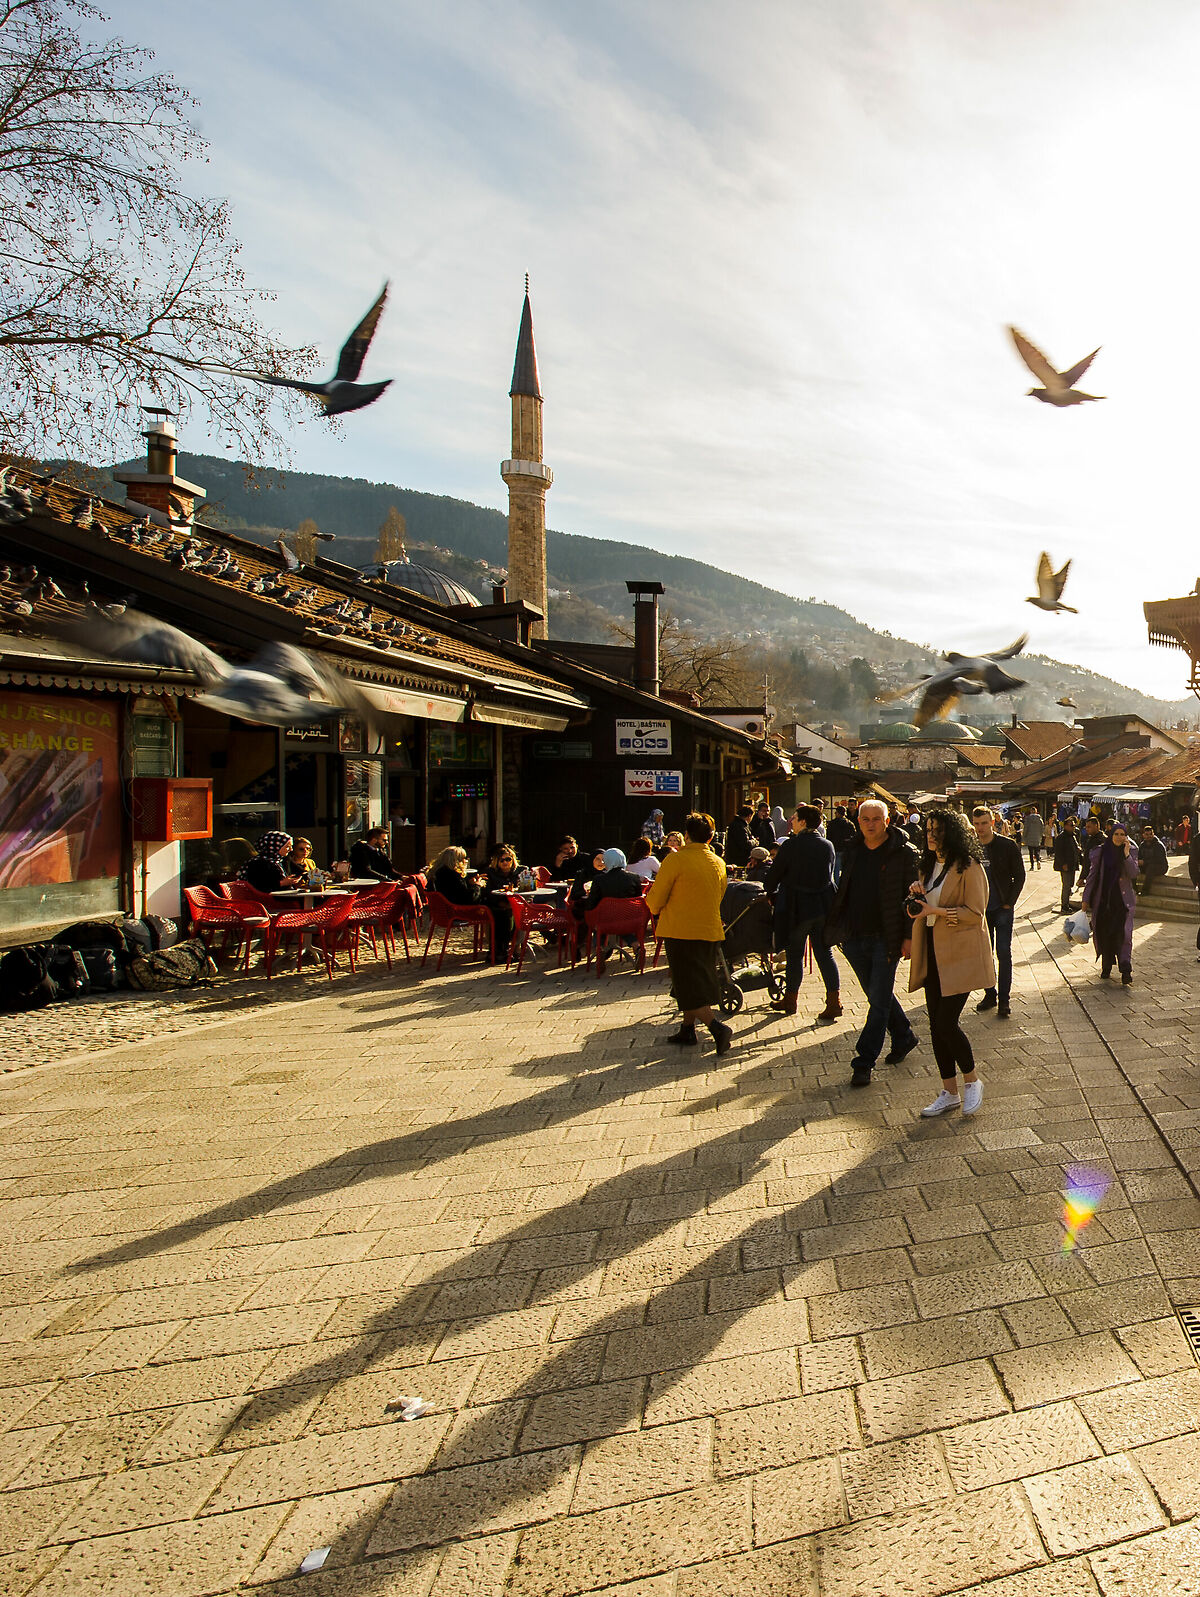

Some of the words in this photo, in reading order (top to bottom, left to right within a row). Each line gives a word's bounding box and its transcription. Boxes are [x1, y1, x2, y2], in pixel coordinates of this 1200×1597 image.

[640, 720, 666, 728] BAŠTINA
[0, 731, 95, 752] CHANGE
[628, 780, 654, 788] WC
